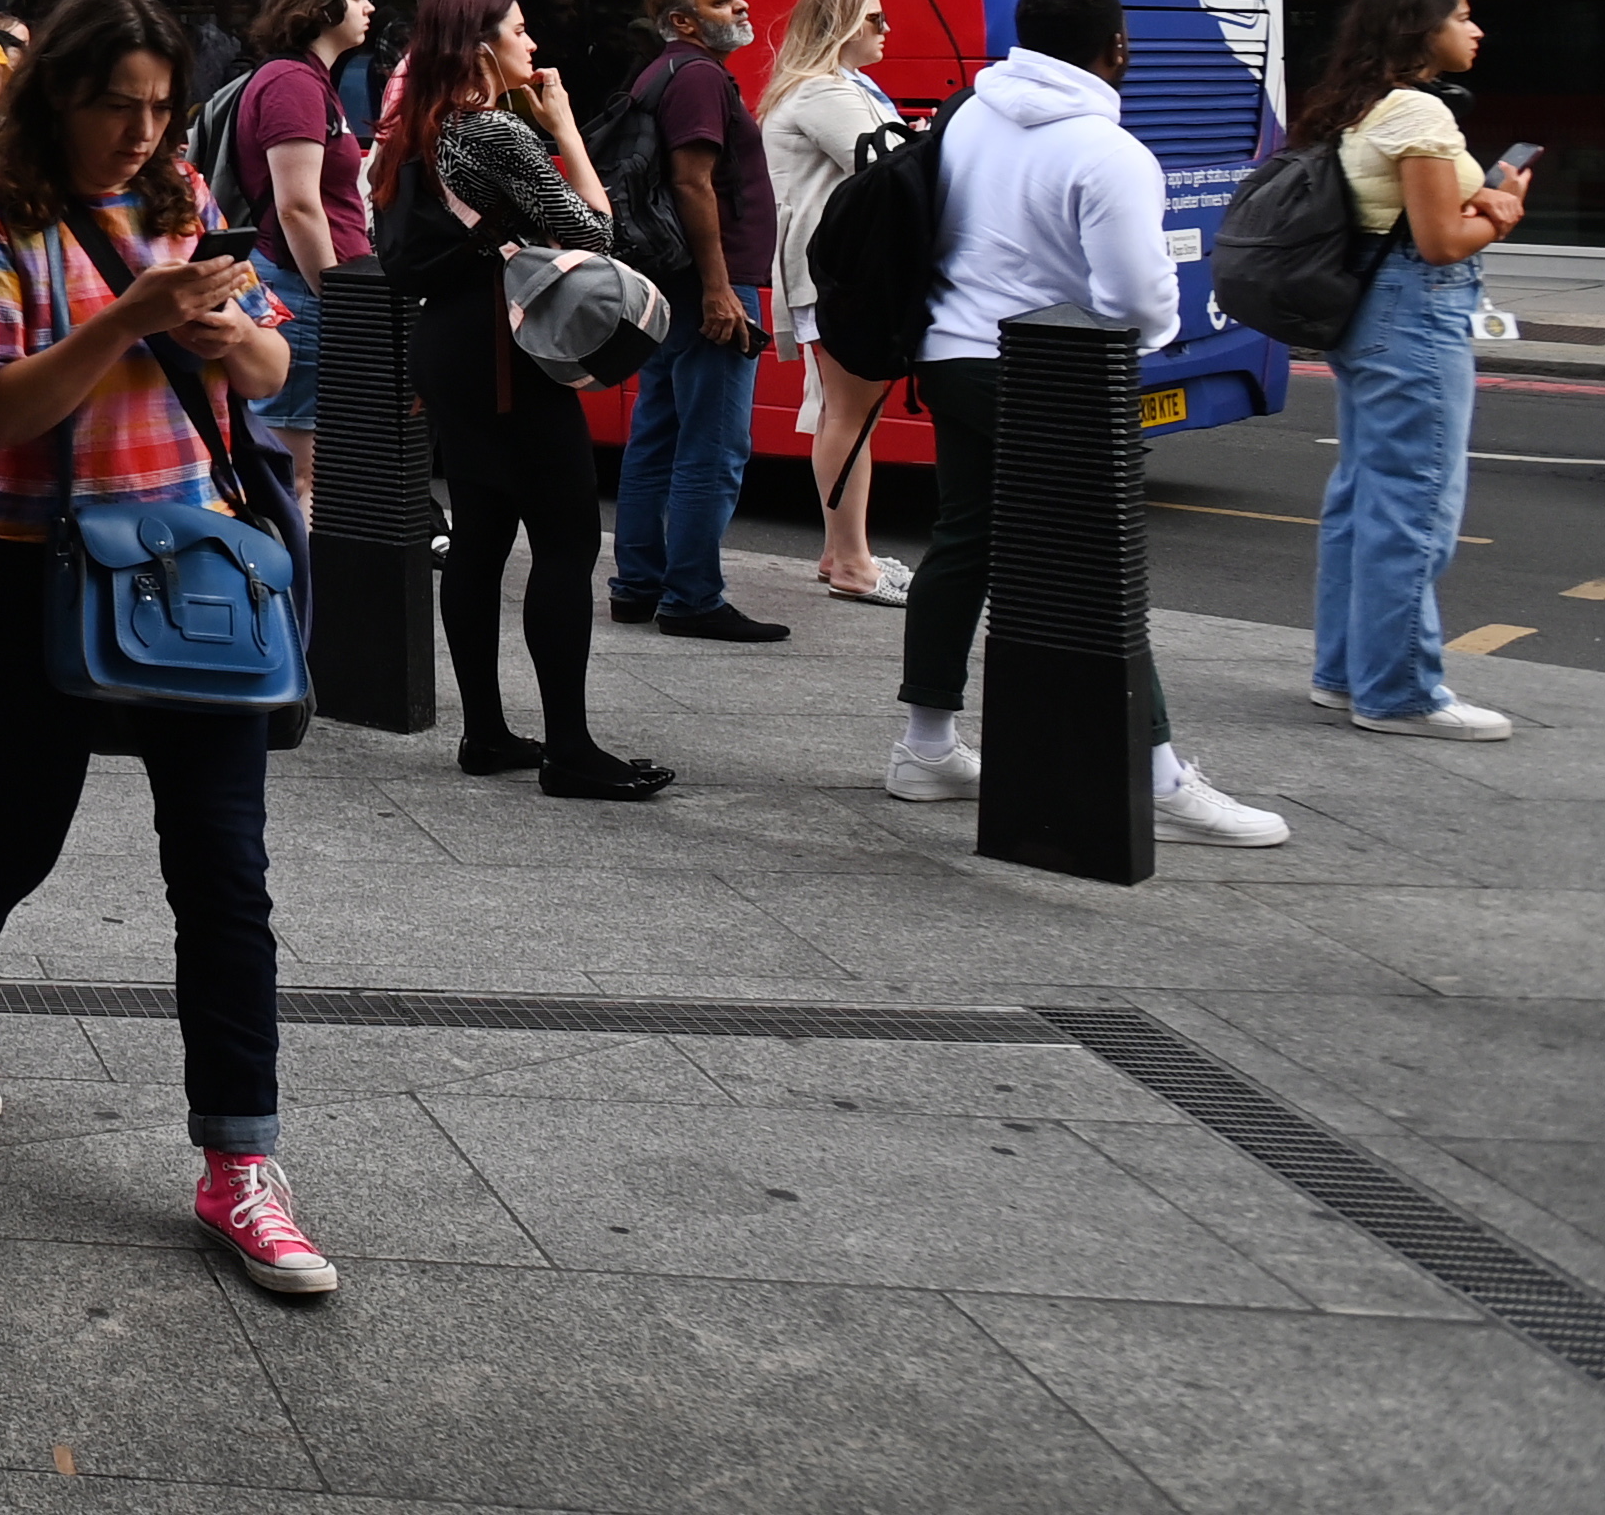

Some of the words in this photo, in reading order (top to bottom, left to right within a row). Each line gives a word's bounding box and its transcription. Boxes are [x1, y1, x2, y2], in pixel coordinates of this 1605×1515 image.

[1167, 172, 1183, 189] app
[1140, 396, 1157, 422] X18
[1158, 392, 1180, 419] KTE
